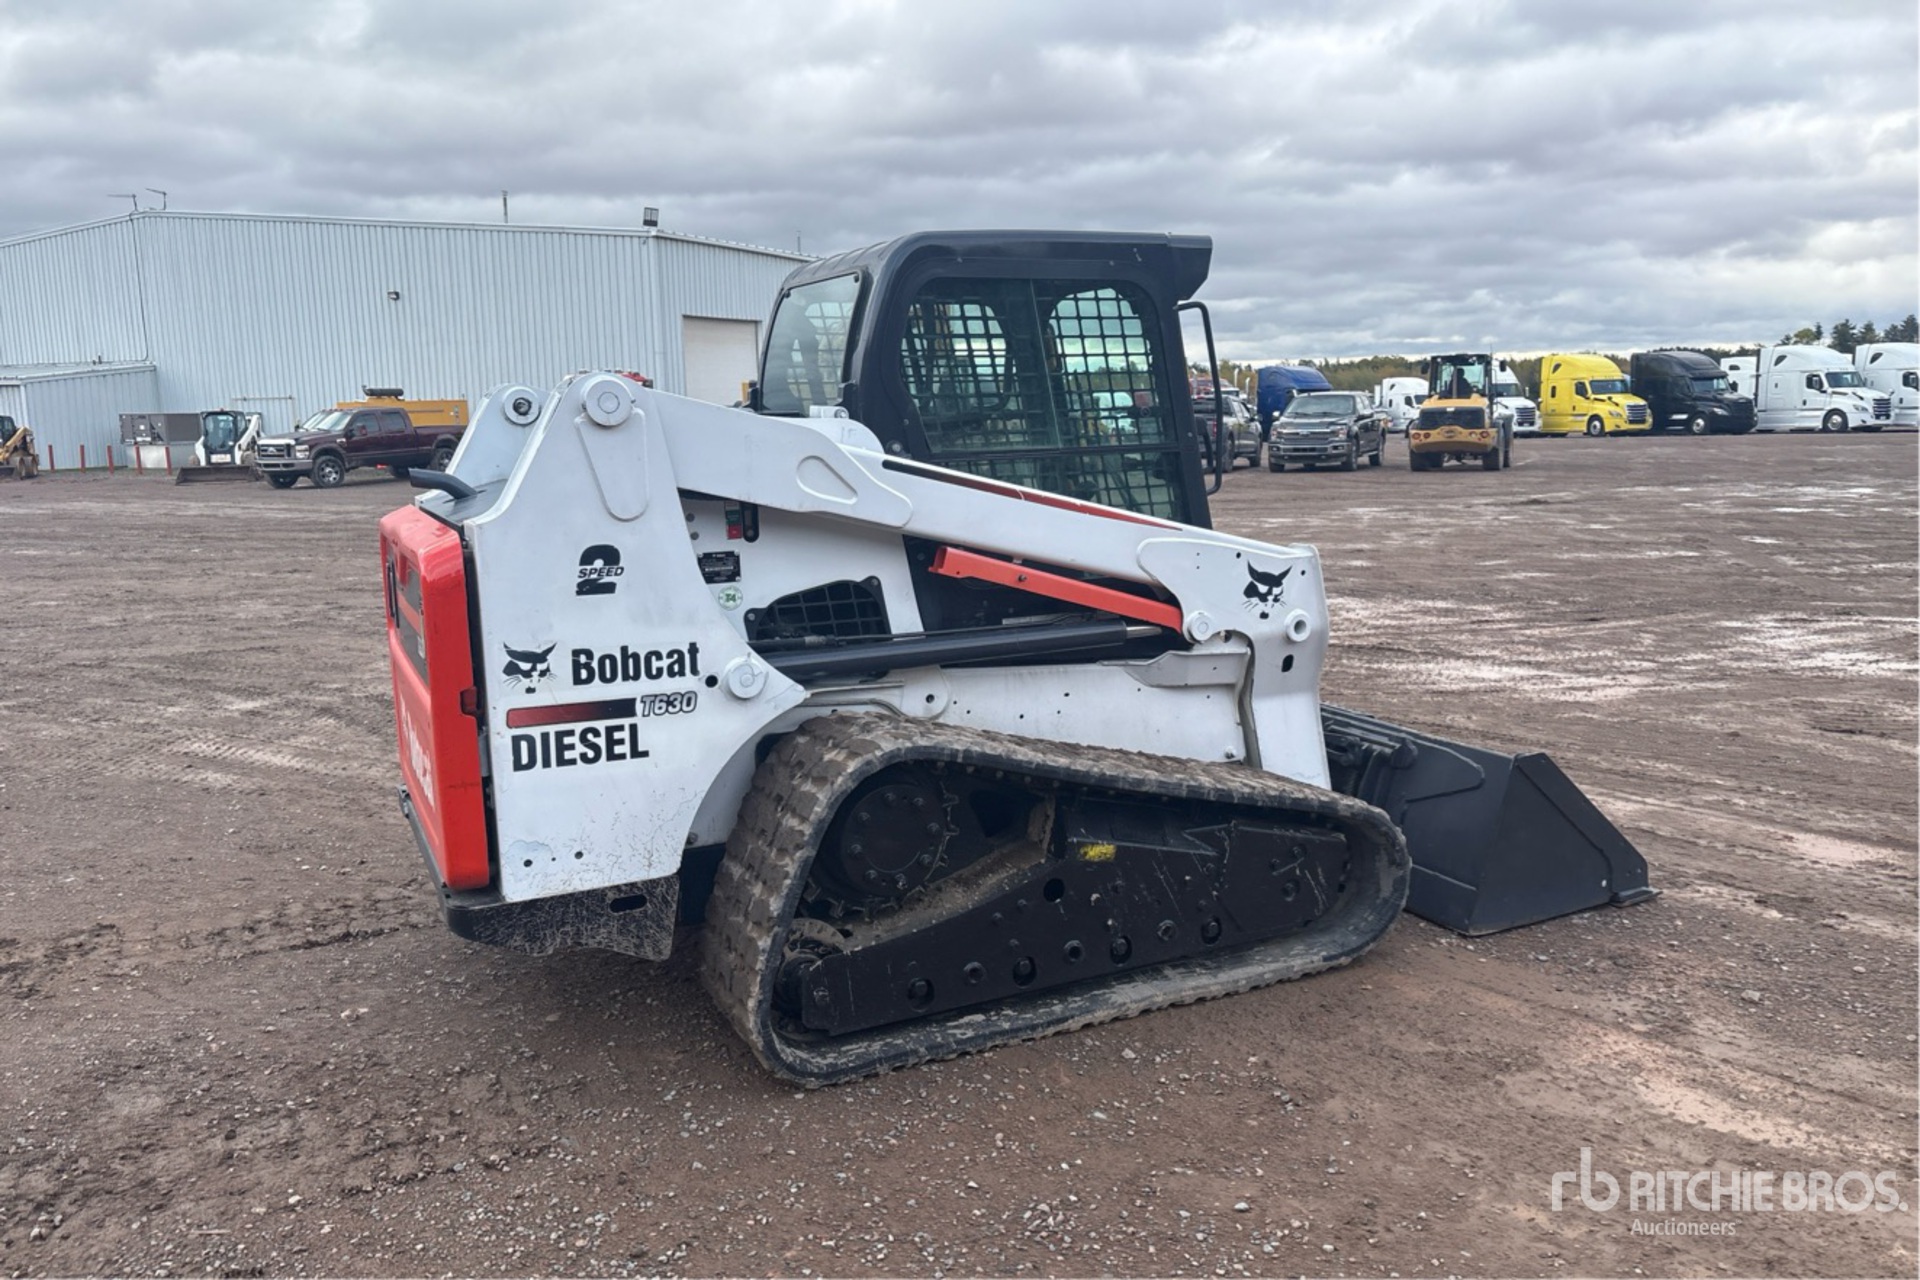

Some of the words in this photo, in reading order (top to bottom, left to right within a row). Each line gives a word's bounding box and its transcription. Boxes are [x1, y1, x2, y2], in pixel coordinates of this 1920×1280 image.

[576, 544, 621, 596] 2
[577, 566, 625, 579] SPEED
[571, 642, 701, 686] Bobcat
[639, 691, 698, 717] T630
[511, 723, 650, 772] DIESEL
